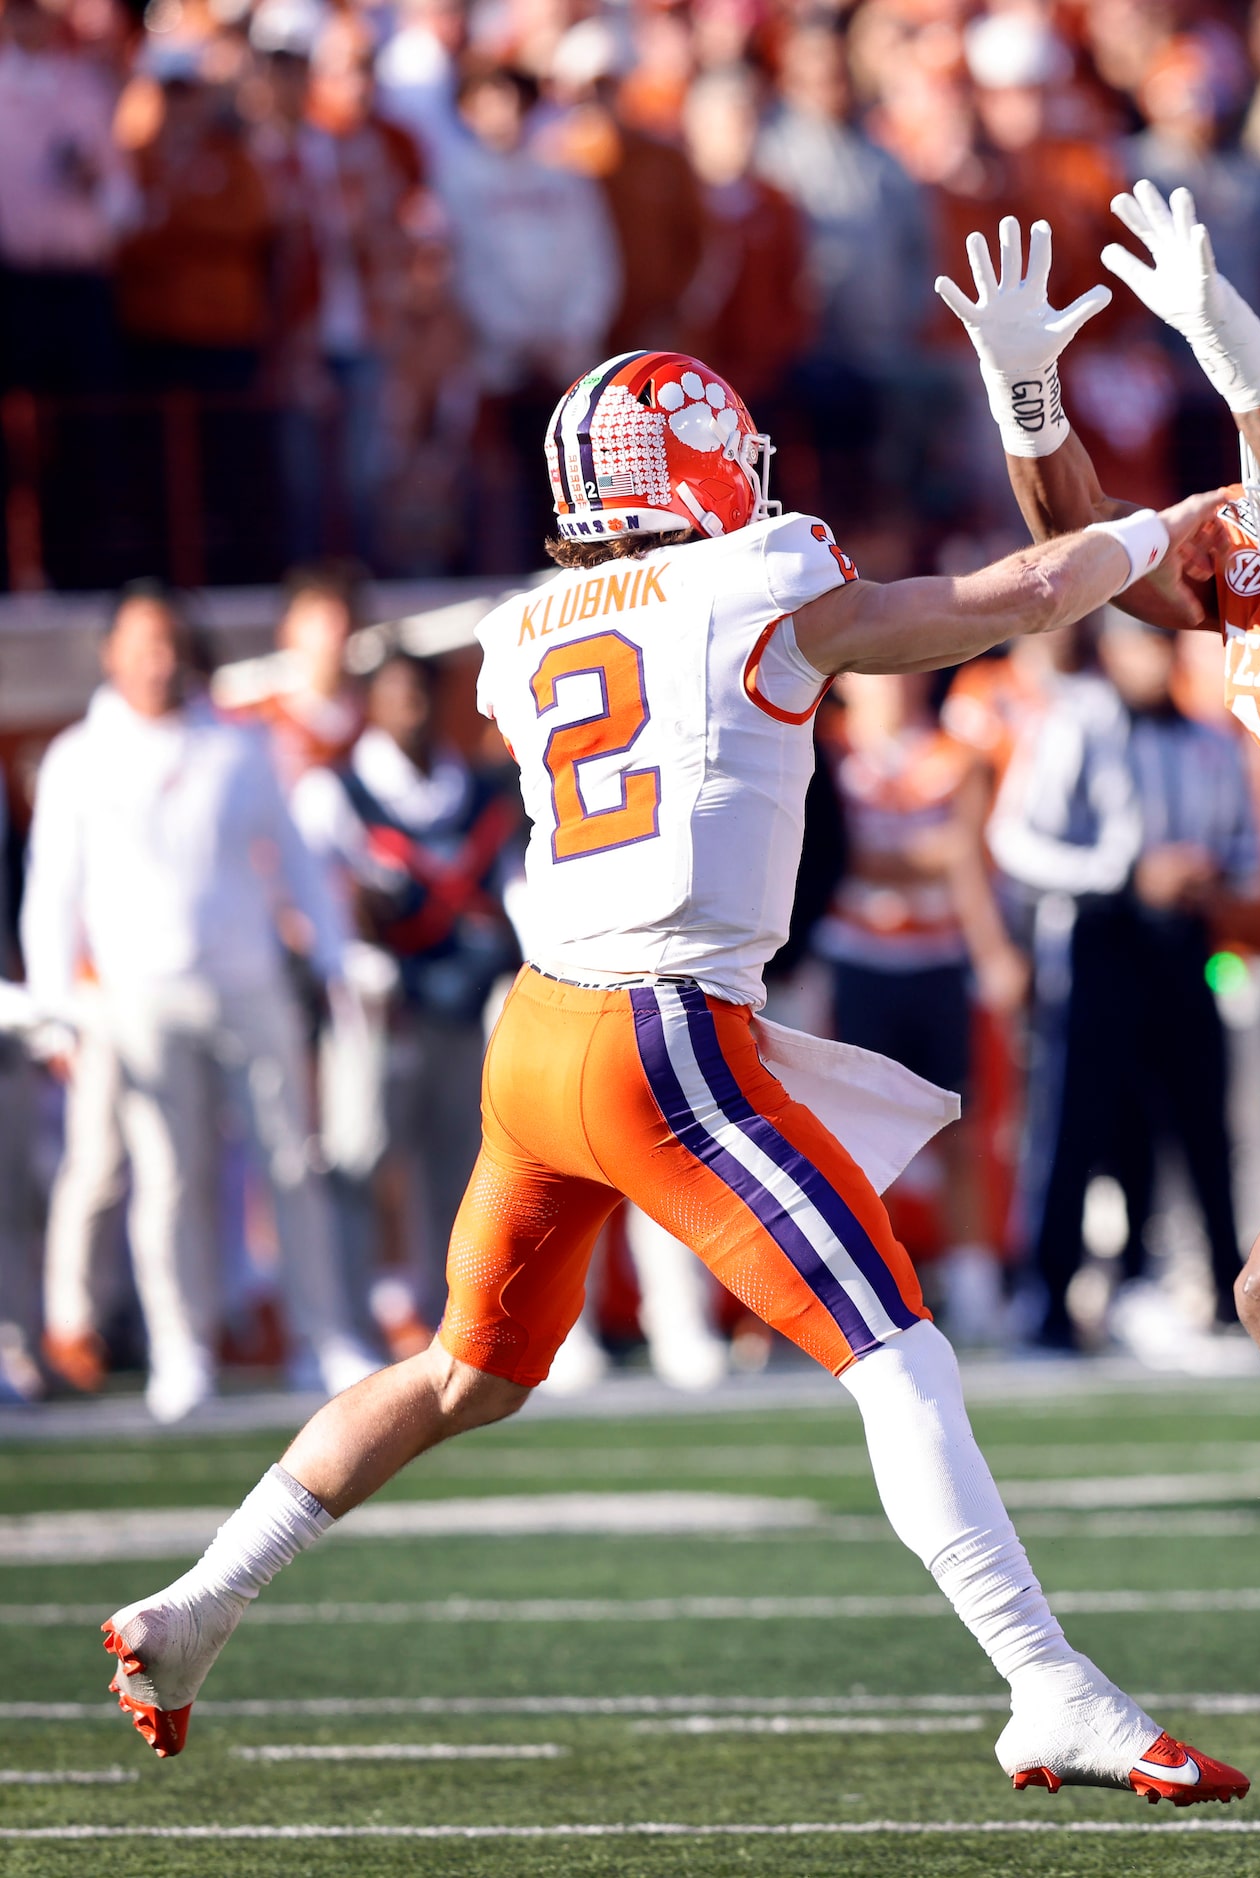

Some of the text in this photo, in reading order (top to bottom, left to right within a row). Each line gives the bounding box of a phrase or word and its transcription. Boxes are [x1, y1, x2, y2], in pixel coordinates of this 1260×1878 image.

[1011, 380, 1045, 432] GOD
[585, 481, 598, 499] 2
[810, 524, 859, 583] 2
[518, 562, 672, 647] KLUBNIK
[529, 629, 661, 864] 2
